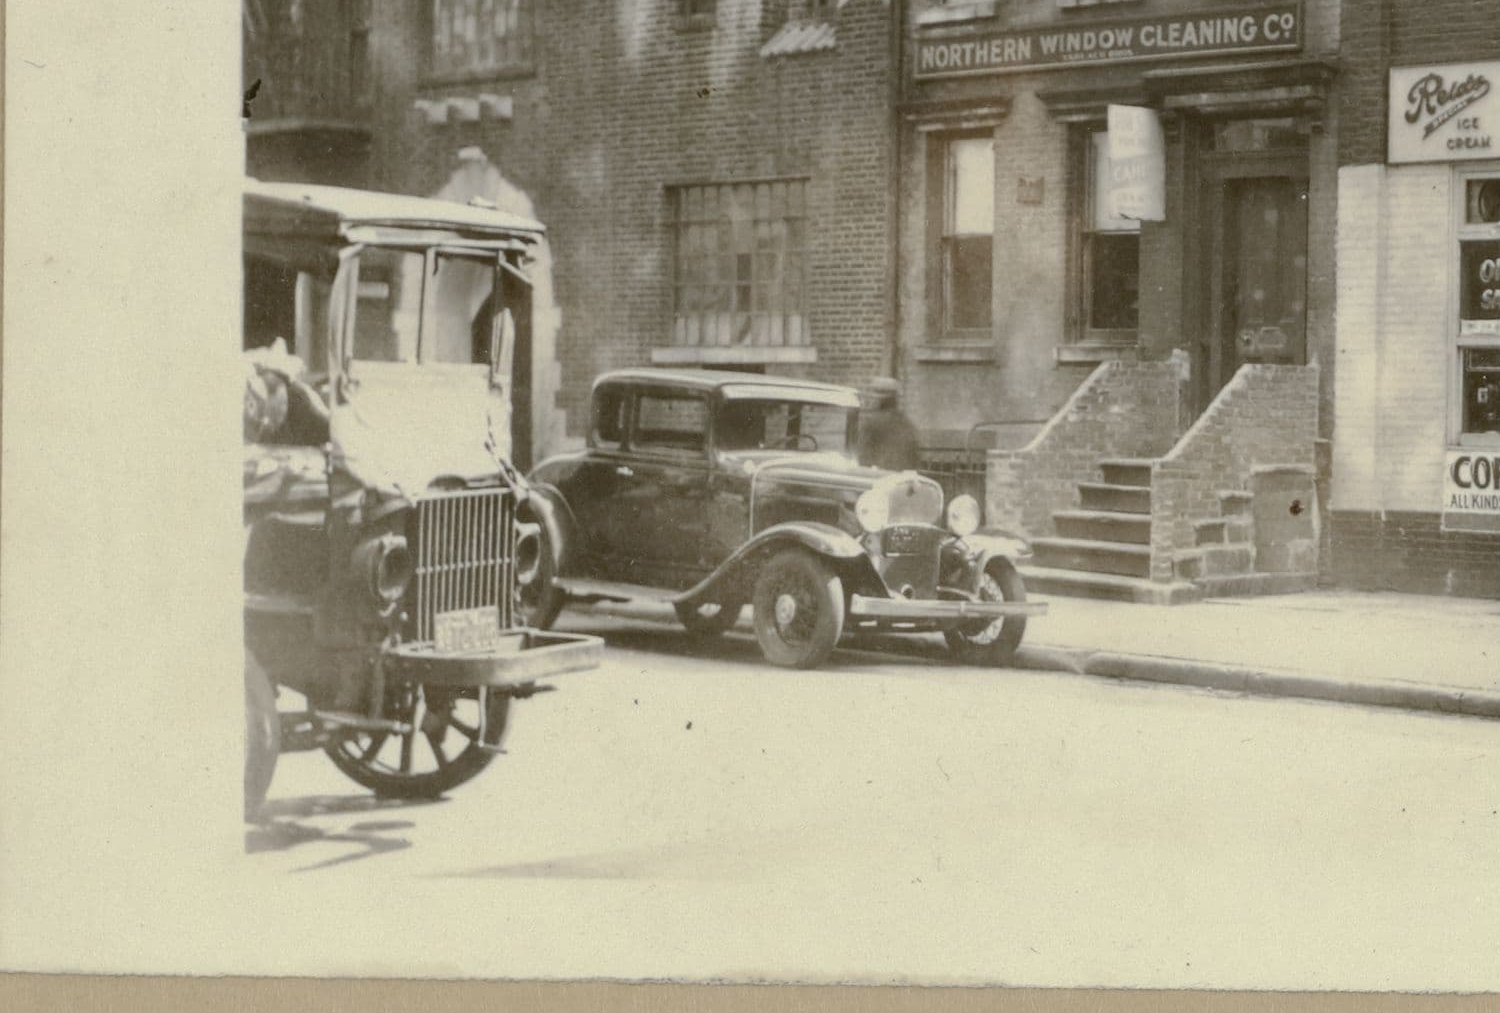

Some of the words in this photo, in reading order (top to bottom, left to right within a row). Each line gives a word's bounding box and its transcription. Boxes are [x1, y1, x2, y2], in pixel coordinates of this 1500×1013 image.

[921, 37, 1032, 70] NORTHERN
[1039, 28, 1133, 55] WINDOW
[1139, 16, 1258, 48] CLEANING
[1457, 117, 1479, 130] ICE
[1446, 136, 1491, 149] CREAM
[1450, 494, 1469, 509] ALL
